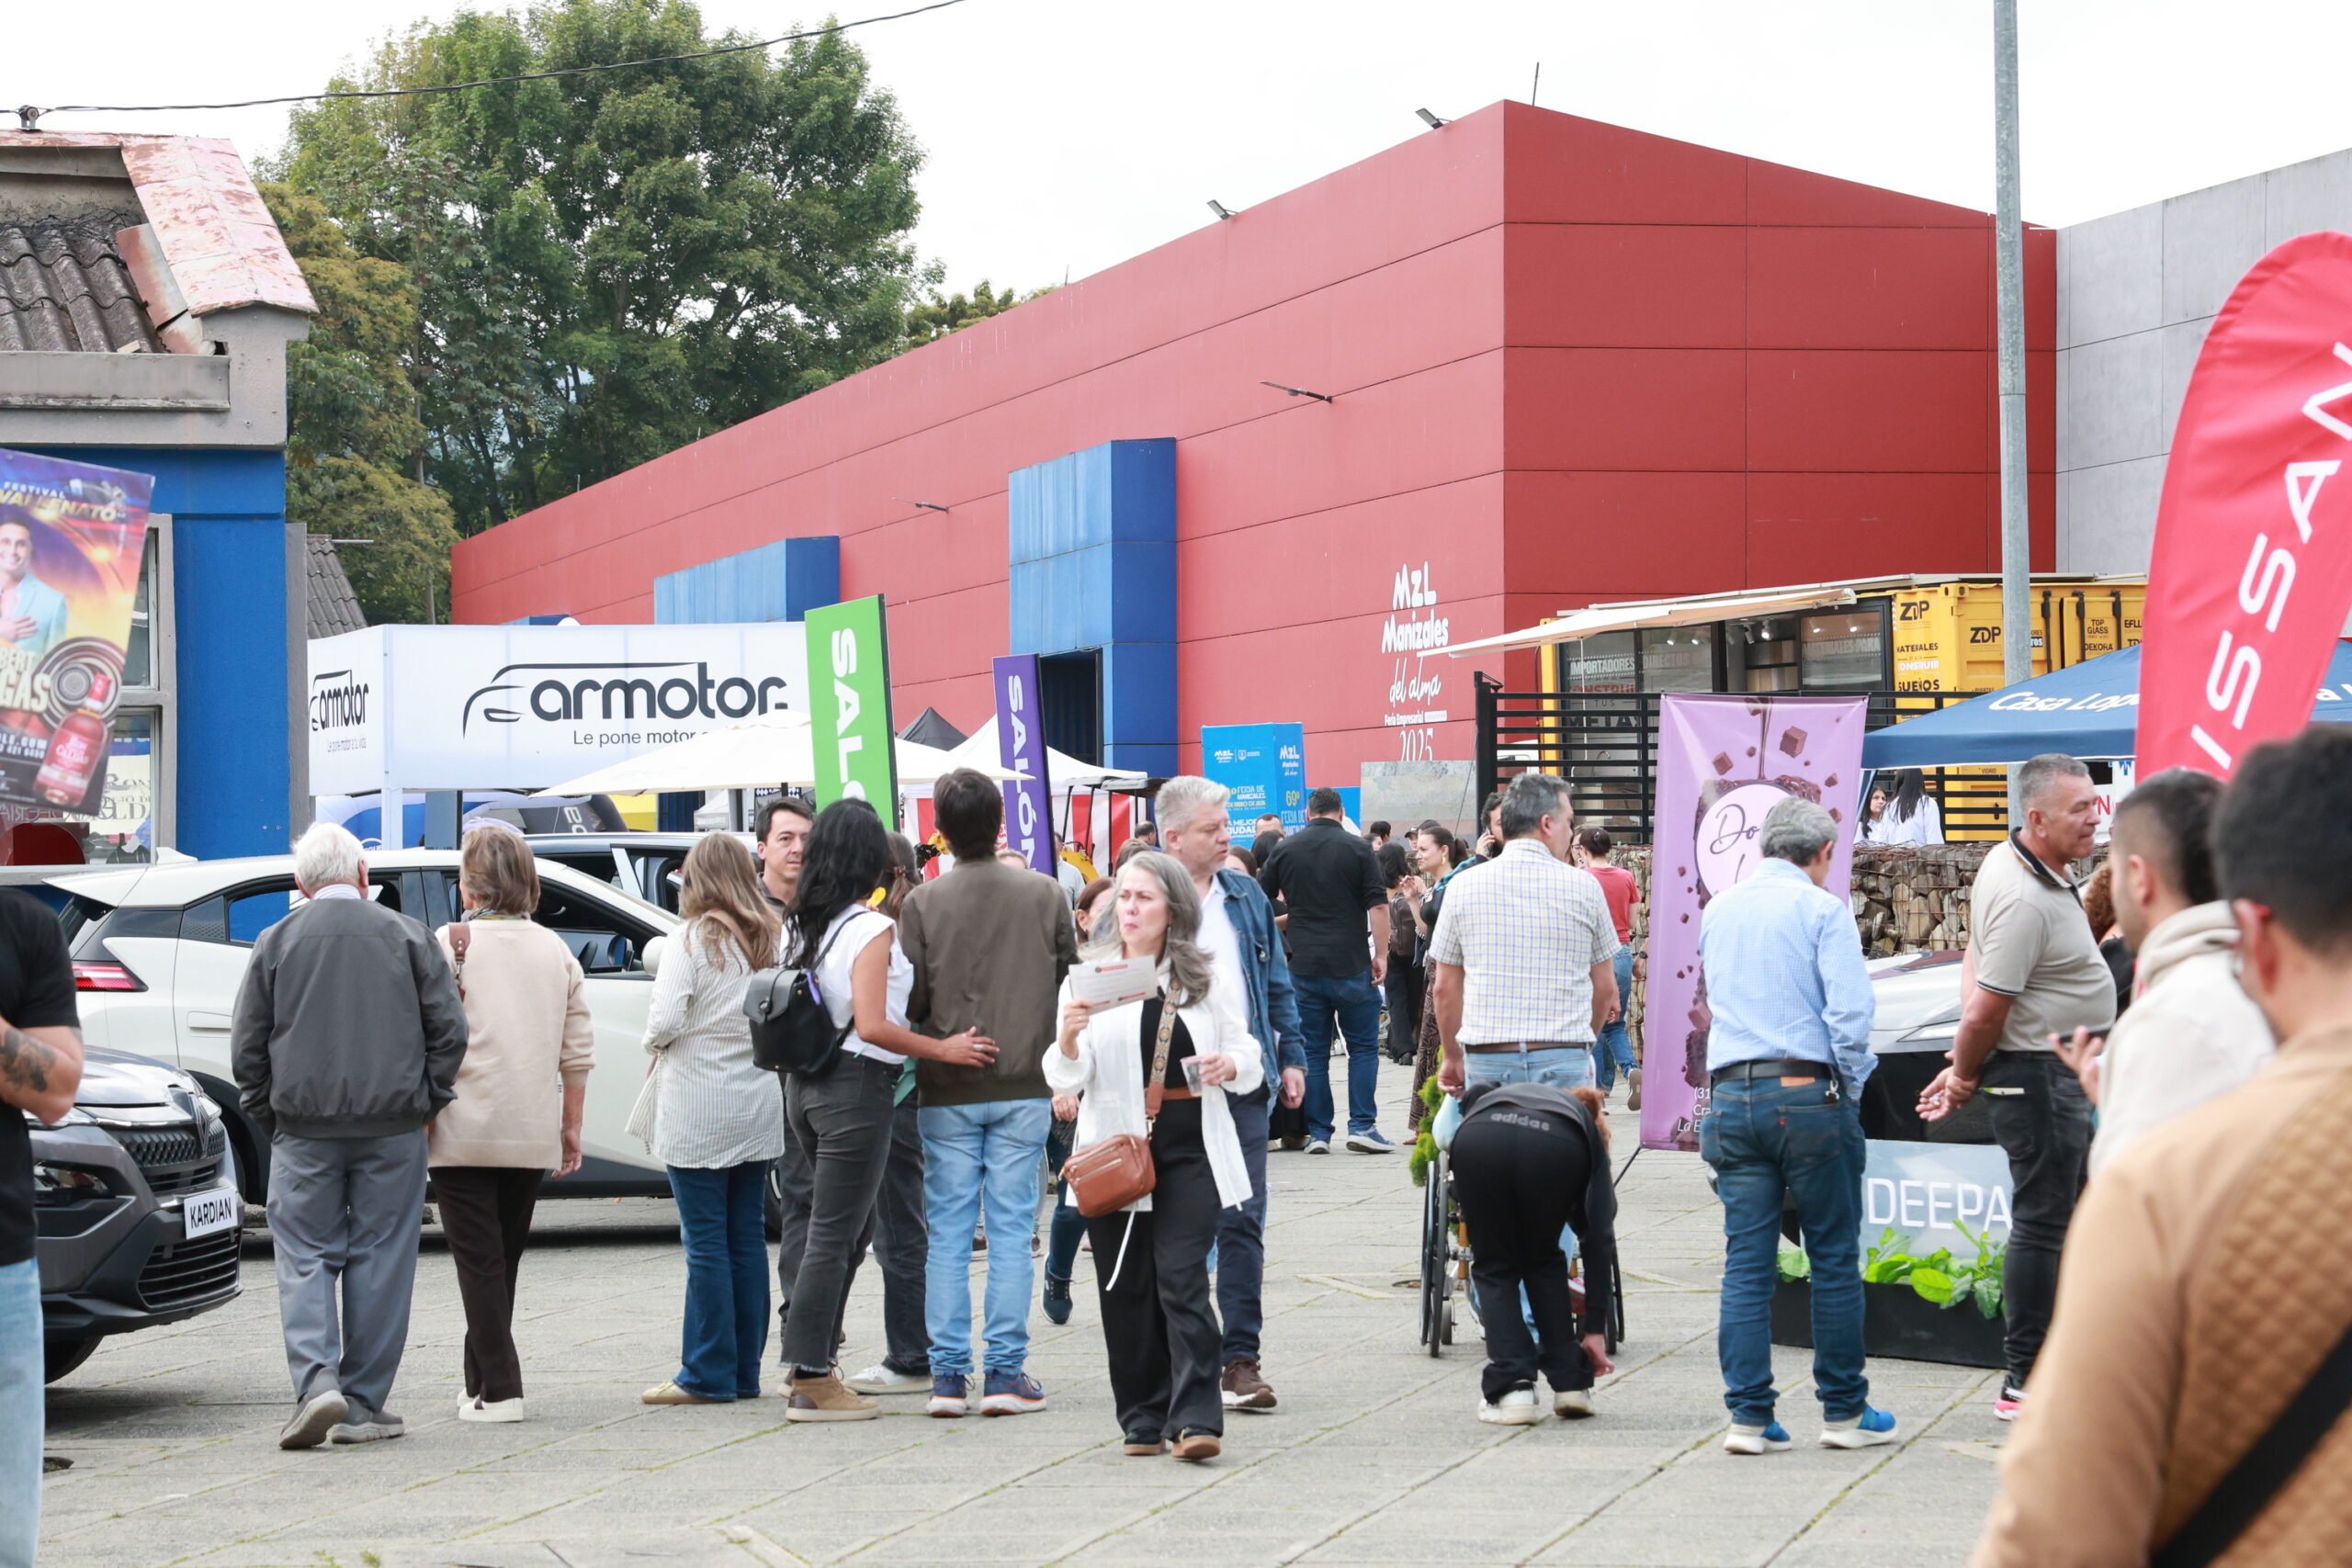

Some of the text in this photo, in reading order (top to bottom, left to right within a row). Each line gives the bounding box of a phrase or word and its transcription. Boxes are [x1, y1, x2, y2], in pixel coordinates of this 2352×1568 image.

[4, 481, 66, 500] FESTIVAL
[0, 489, 117, 523] VALLENATO
[2179, 341, 2352, 773] ISSAN
[1900, 601, 1929, 621] ZDP
[1382, 608, 1449, 654] Manizales
[1970, 626, 2001, 643] ZDP
[2086, 626, 2109, 635] GLASS
[1570, 657, 1635, 676] IMPORTADORES
[530, 662, 787, 722] armotor
[1390, 656, 1442, 708] del alma
[319, 669, 369, 730] armotor
[1595, 699, 1615, 707] TUS
[1988, 692, 2073, 712] Casa
[573, 729, 696, 748] Le pone motor
[1399, 728, 1433, 761] 2025
[1710, 804, 1774, 855] Do
[1694, 1087, 1711, 1100] (31
[1491, 1112, 1550, 1132] adidas
[190, 1197, 232, 1229] KARDIAN
